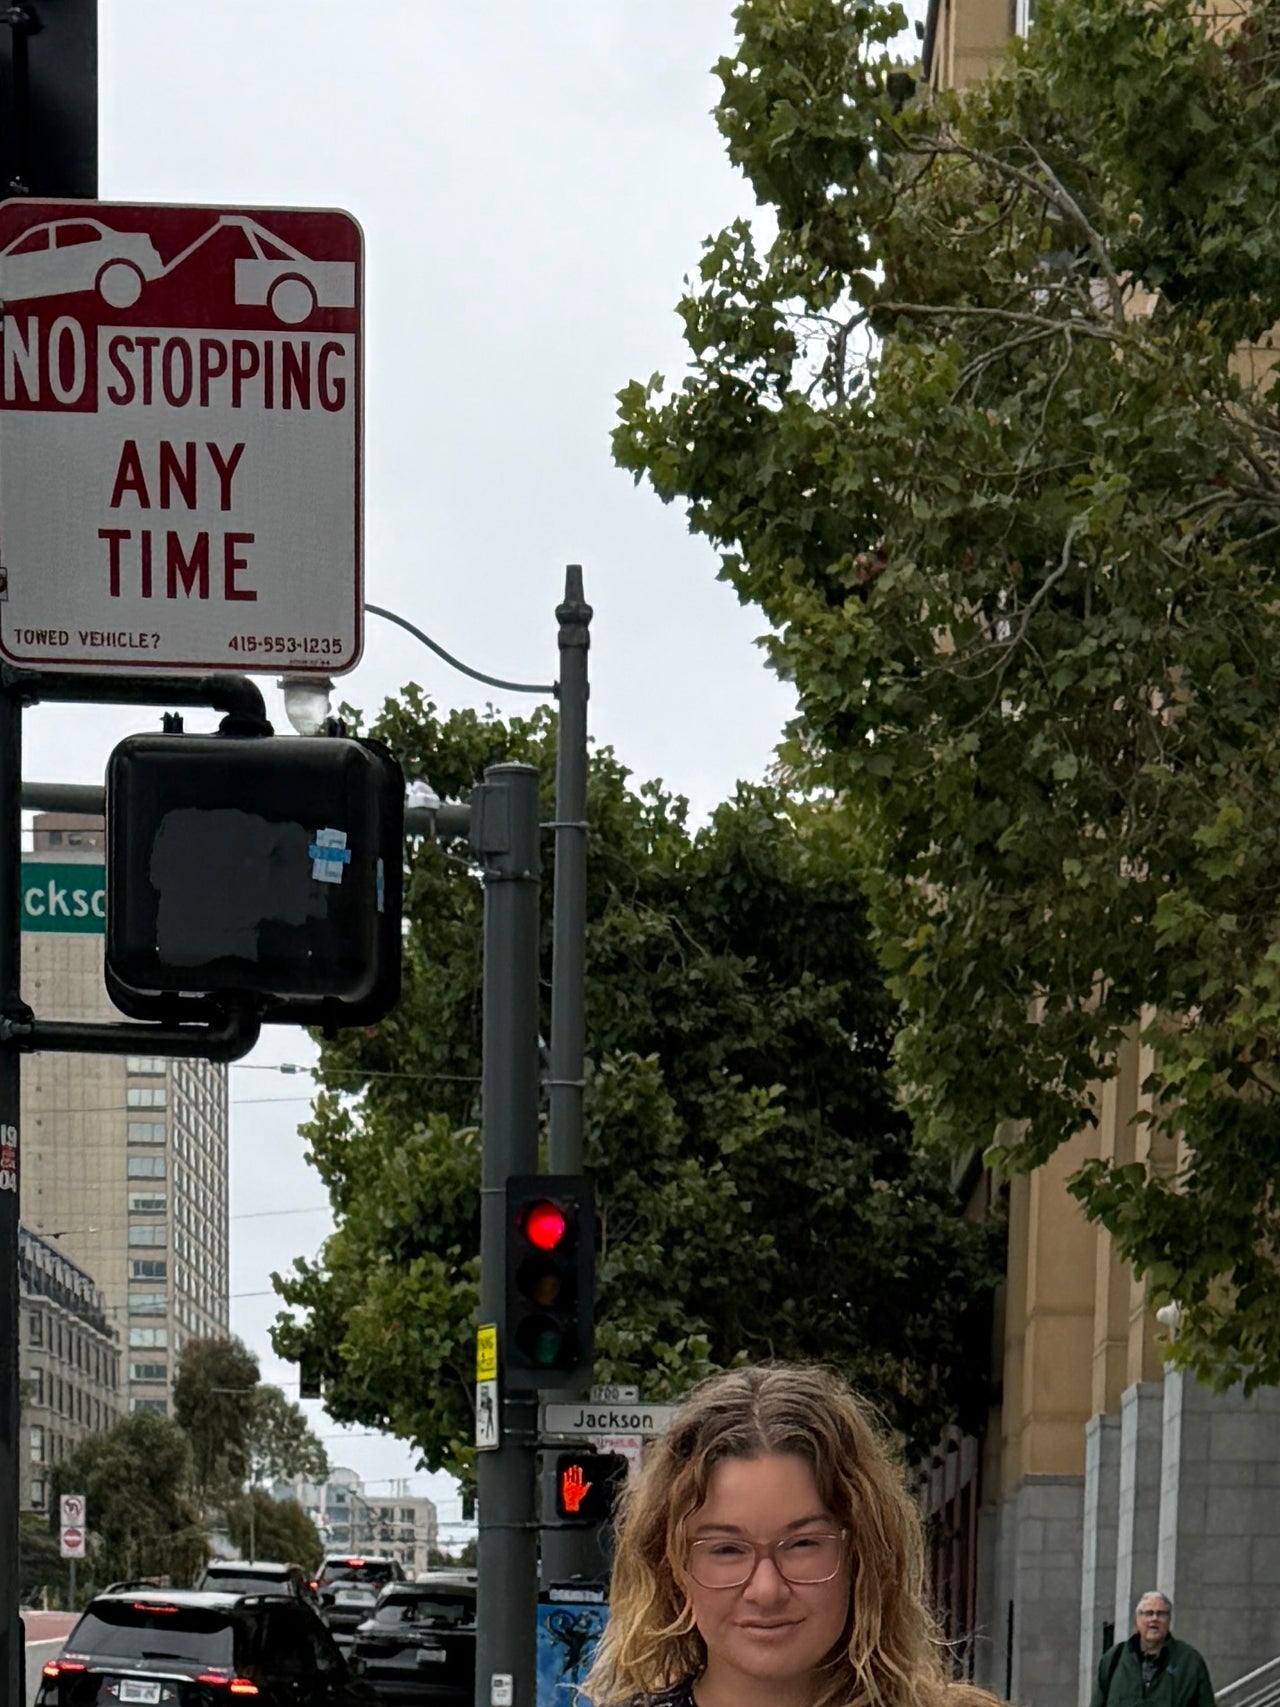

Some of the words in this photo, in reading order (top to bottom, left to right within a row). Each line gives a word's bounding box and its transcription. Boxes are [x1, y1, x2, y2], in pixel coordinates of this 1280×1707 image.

[3, 314, 87, 404] NO
[107, 334, 347, 412] STOPPING
[109, 439, 246, 511] ANY
[98, 528, 258, 601] TIME
[13, 628, 70, 647] TOWED
[78, 630, 161, 649] VEHICLE?
[573, 1410, 654, 1429] Jackson
